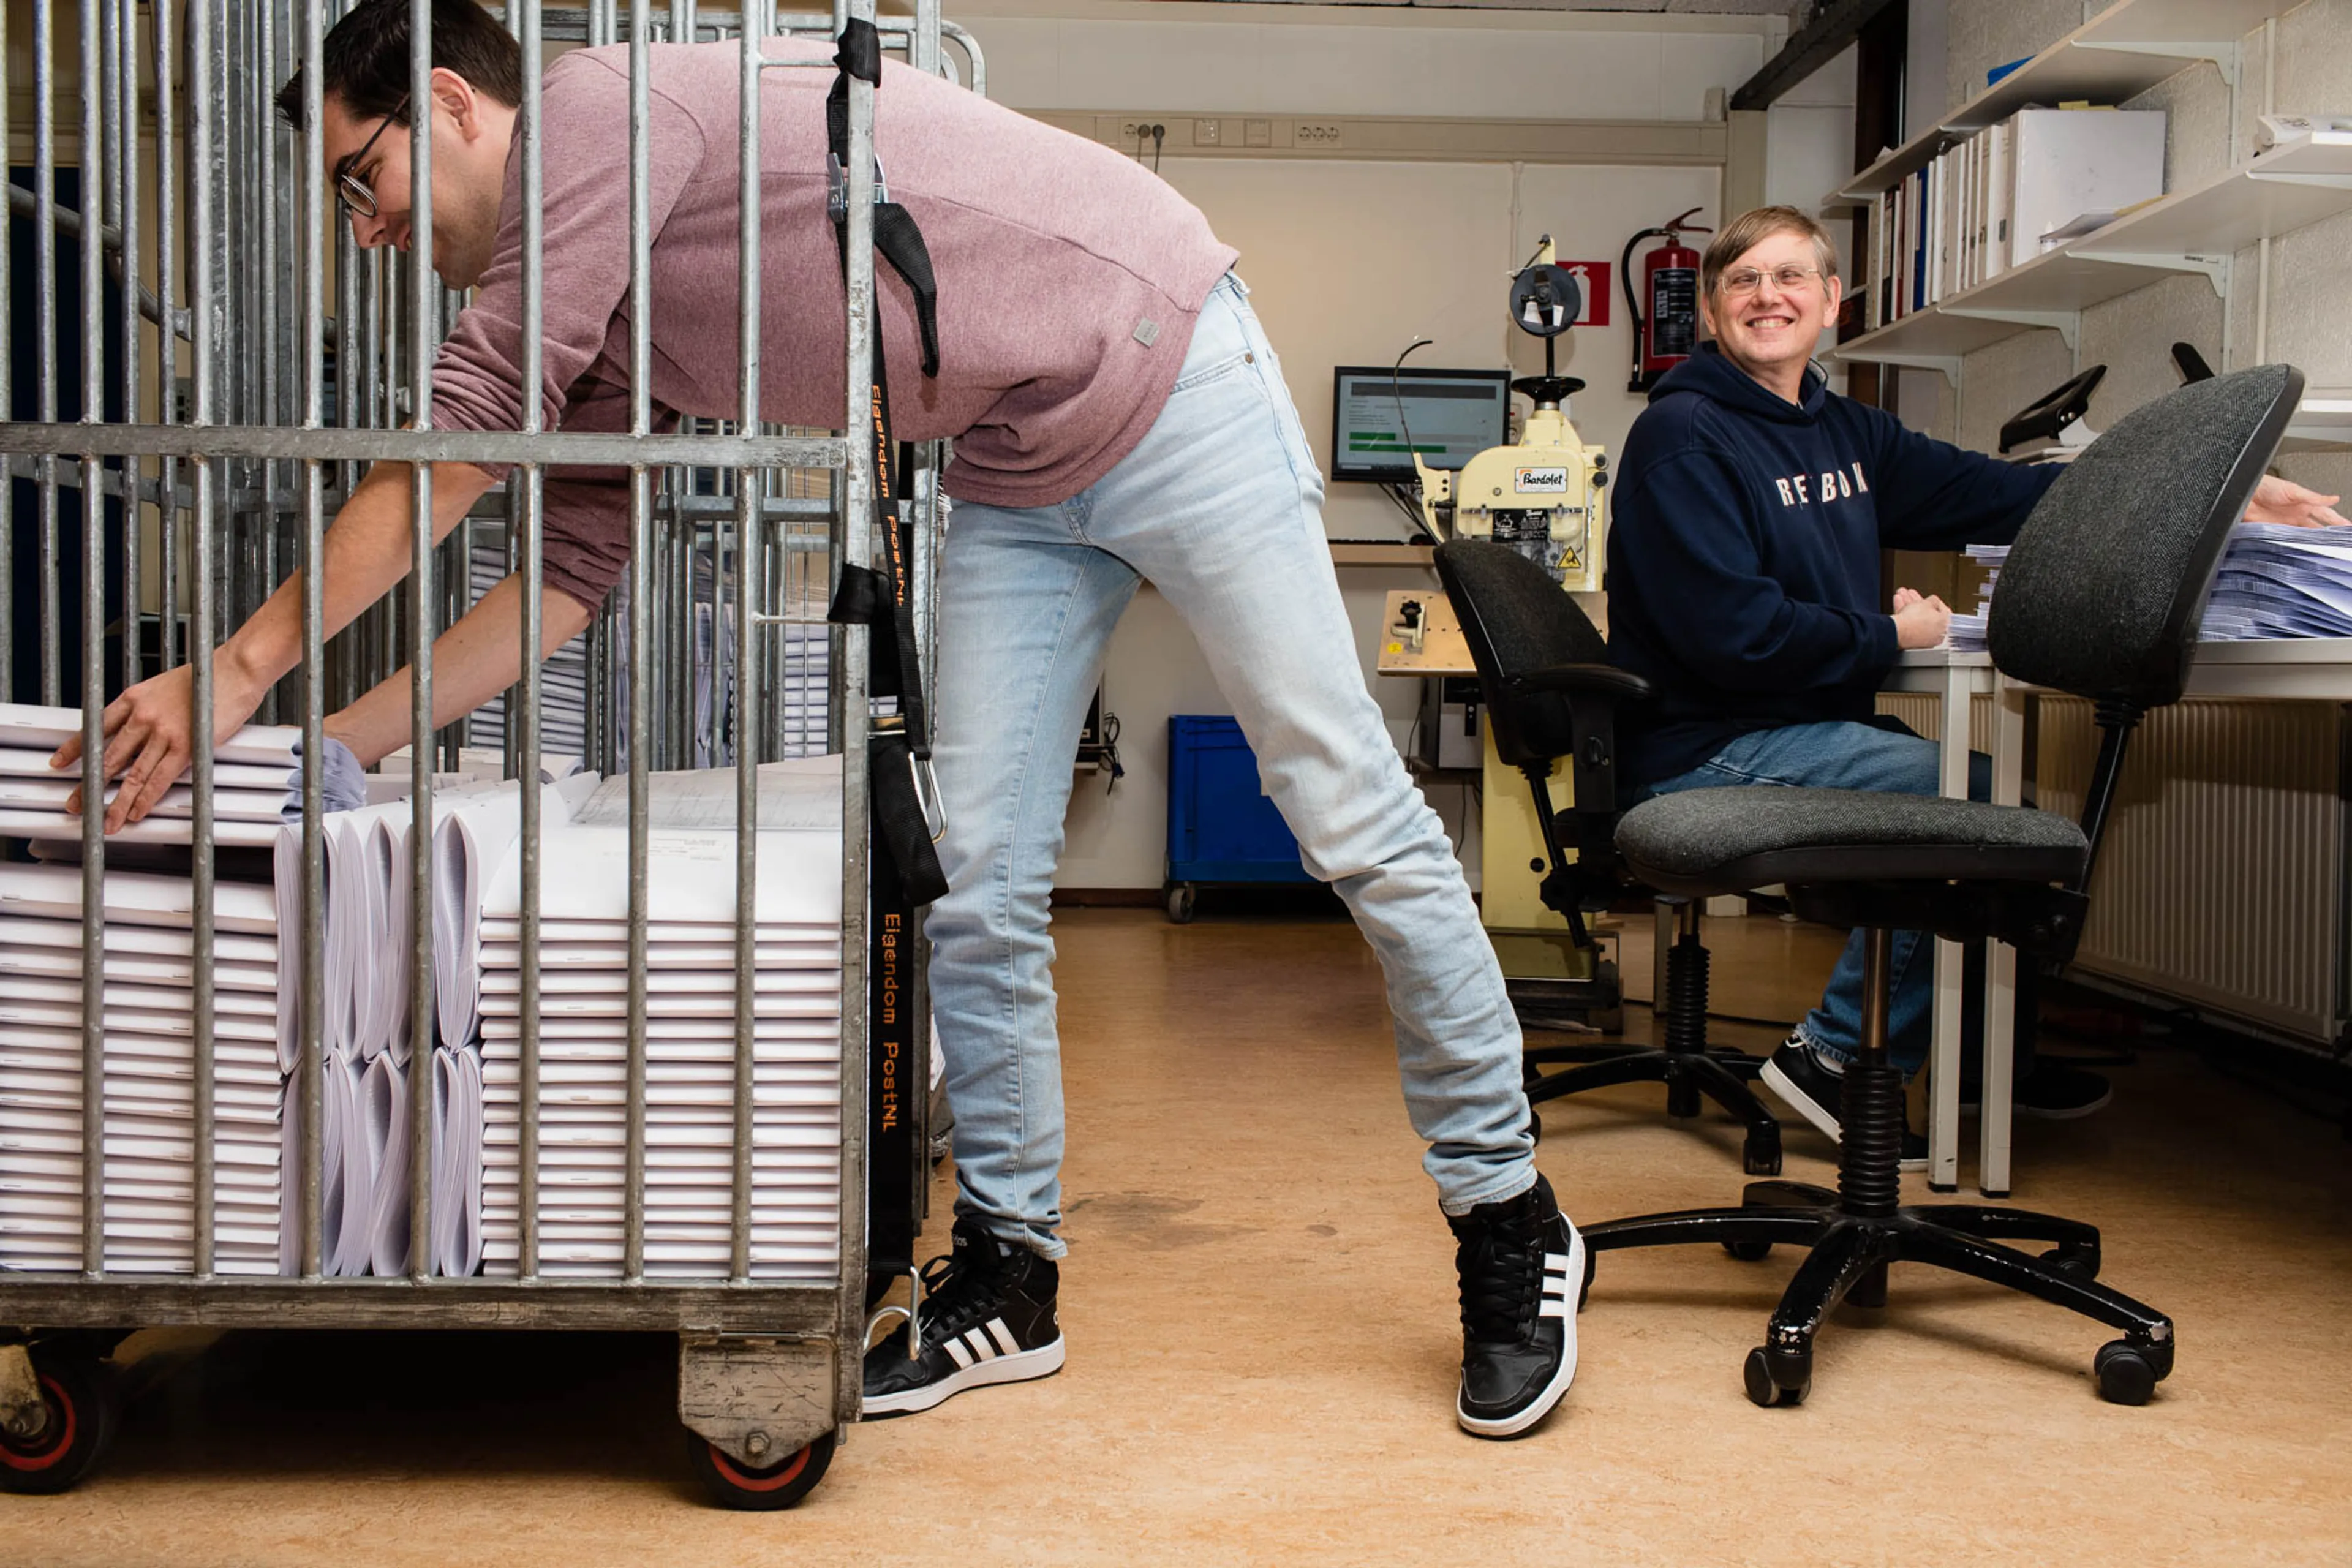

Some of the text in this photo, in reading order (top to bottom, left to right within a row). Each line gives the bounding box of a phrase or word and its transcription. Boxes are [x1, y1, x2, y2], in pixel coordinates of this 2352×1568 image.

[872, 385, 889, 499] Eigendom
[1776, 462, 1868, 507] REBOK
[882, 914, 900, 1133] Eigendom PostNL
